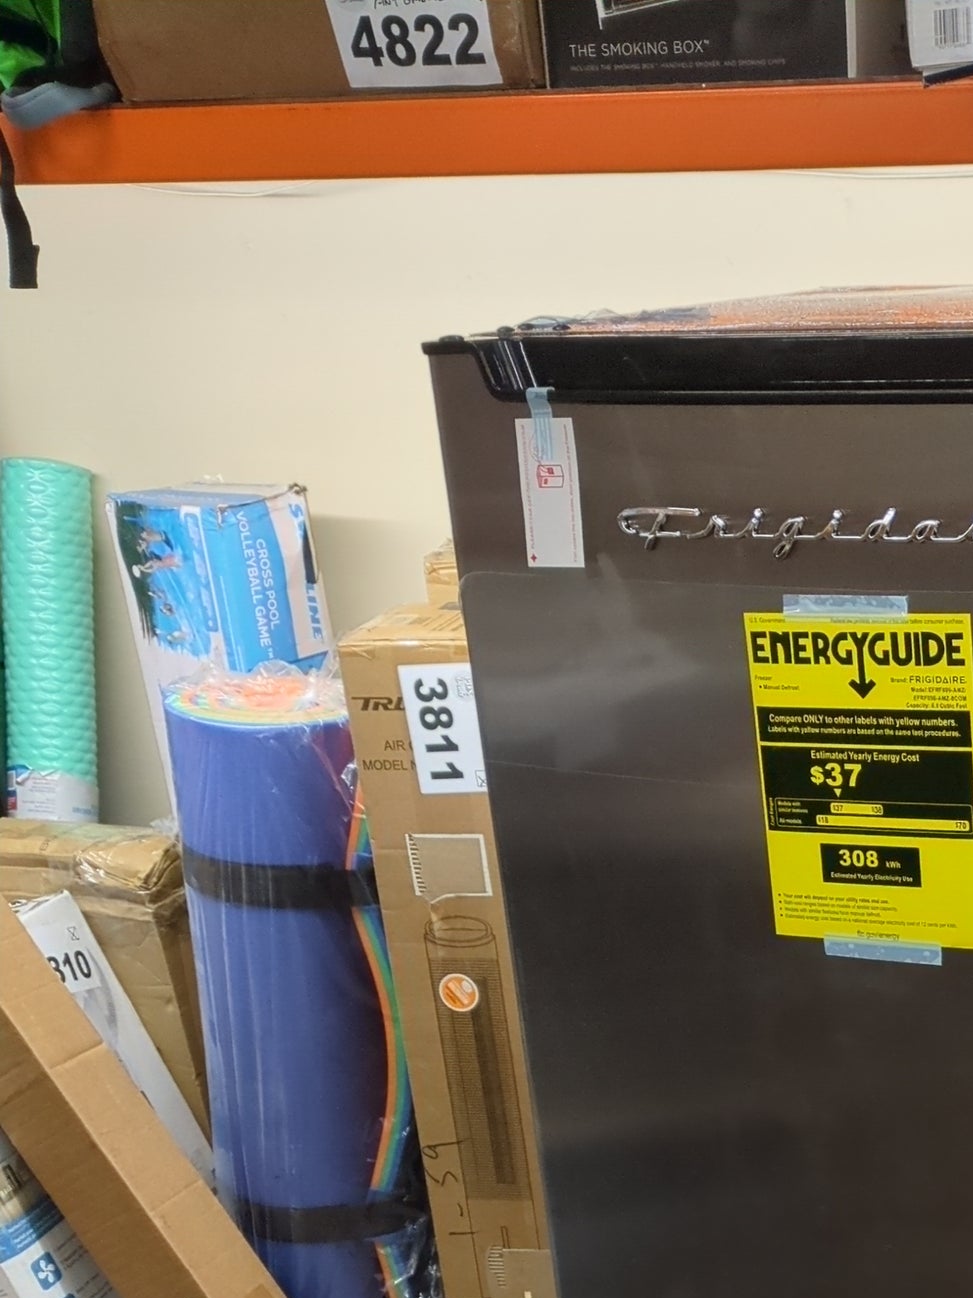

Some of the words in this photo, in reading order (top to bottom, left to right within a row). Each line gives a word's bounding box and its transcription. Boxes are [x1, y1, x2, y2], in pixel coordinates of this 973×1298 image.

[351, 13, 486, 67] 4822
[569, 44, 596, 57] THE
[601, 41, 668, 56] SMOKING
[235, 511, 262, 605] VOLLEYBALL
[255, 538, 274, 588] CROSS
[265, 590, 280, 630] POOL
[750, 630, 966, 667] ENERGYGUIDE
[414, 678, 465, 780] 3811
[769, 713, 802, 725] Compare
[803, 713, 824, 724] ONLY
[825, 716, 834, 724] to
[834, 715, 853, 725] other
[854, 714, 877, 726] labels
[878, 716, 894, 726] with
[895, 716, 920, 728] yellow
[921, 717, 959, 727] numbers.
[768, 726, 787, 734] Labels
[788, 726, 800, 734] with
[801, 727, 820, 736] yellow
[821, 727, 846, 735] numbers
[857, 728, 875, 736] based
[924, 730, 961, 738] procedures.
[384, 740, 406, 751] AIR
[362, 760, 408, 771] MODEL
[810, 750, 848, 760] Estimated
[849, 751, 872, 763] Yearly
[873, 752, 900, 764] Energy
[901, 752, 920, 763] Cost
[810, 762, 862, 787] $37
[839, 849, 879, 868] 308
[886, 861, 901, 869] kWh
[857, 873, 874, 881] Yearly
